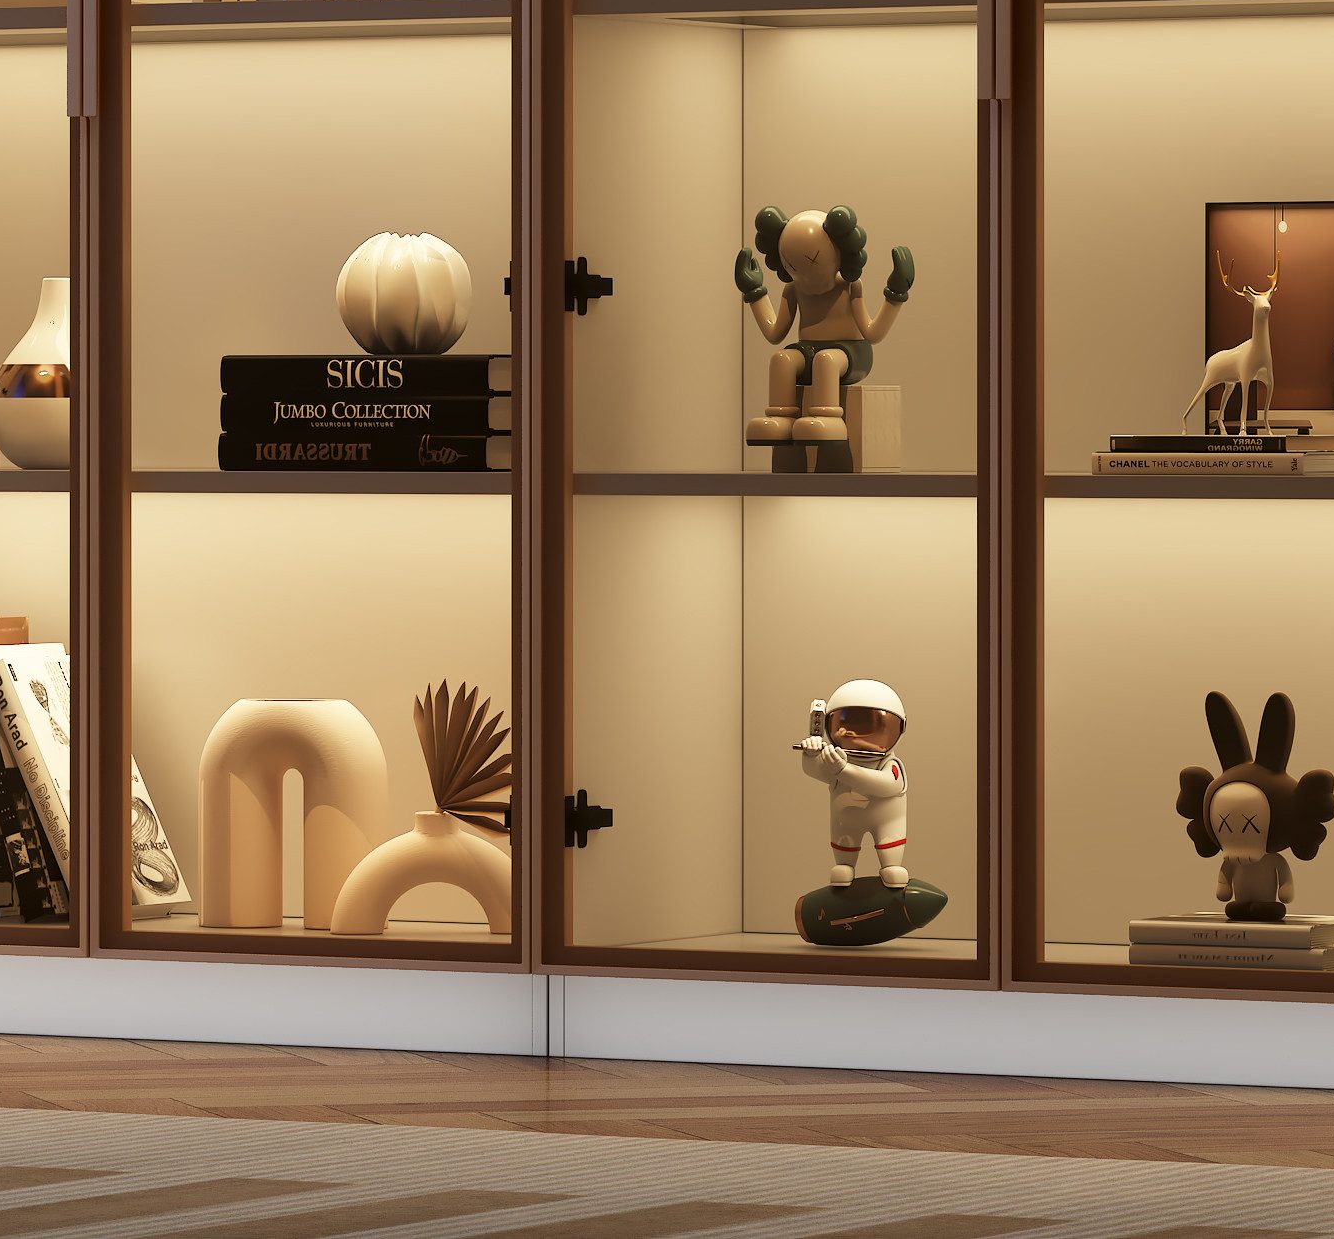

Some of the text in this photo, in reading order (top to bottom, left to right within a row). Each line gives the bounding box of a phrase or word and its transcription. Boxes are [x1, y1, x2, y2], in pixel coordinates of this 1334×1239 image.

[327, 359, 403, 388] SICIS
[1109, 460, 1150, 469] CHANEL
[1152, 460, 1168, 468] THE
[1170, 460, 1229, 468] VOCABULARY
[1232, 460, 1244, 468] OF
[1246, 460, 1273, 468] STYLE
[4, 714, 27, 751] Arad
[23, 756, 38, 784] No
[34, 783, 70, 861] Discipline
[133, 840, 168, 851] Ron Arad
